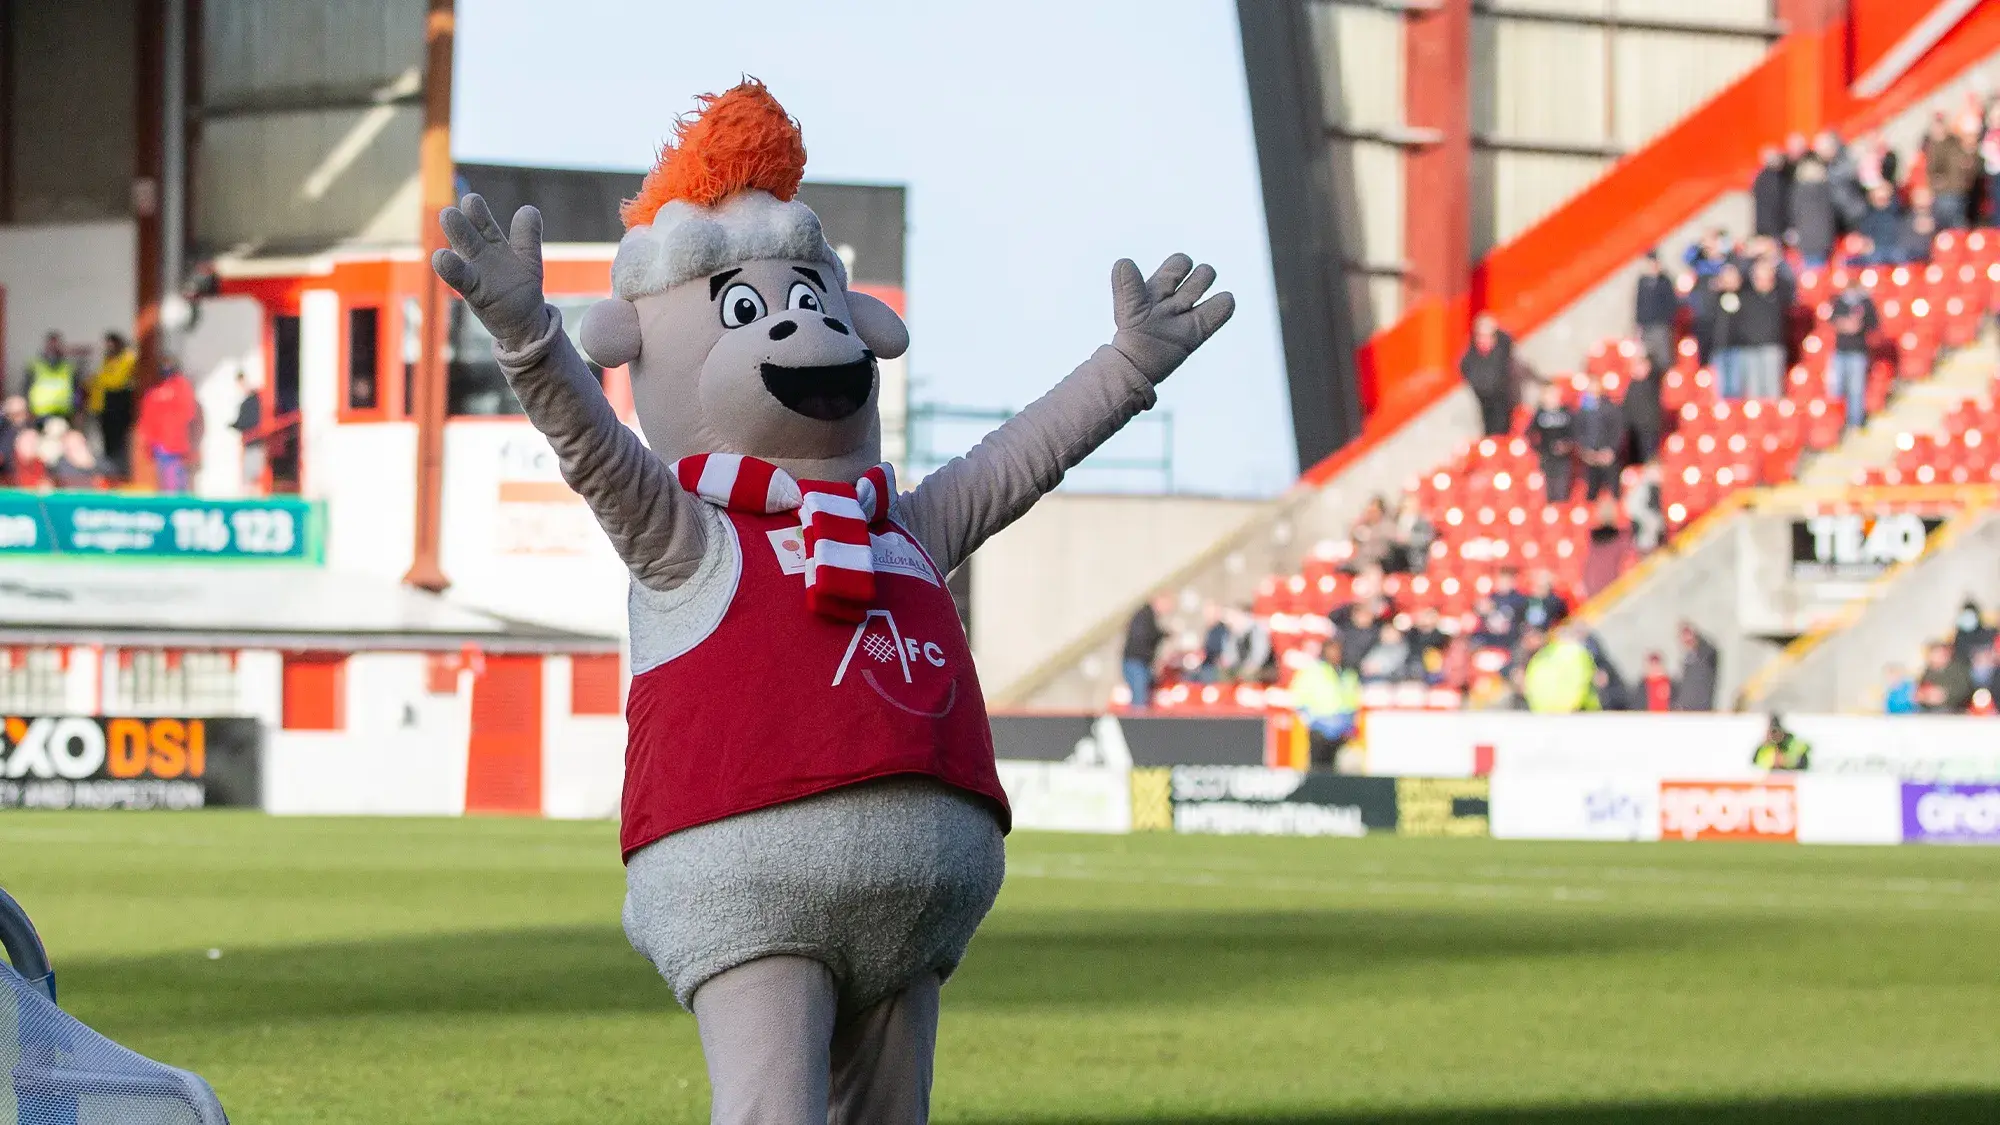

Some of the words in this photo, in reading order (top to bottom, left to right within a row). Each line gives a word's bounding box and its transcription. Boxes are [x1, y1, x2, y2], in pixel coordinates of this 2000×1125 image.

[170, 508, 230, 552] 116
[231, 508, 295, 553] 123
[872, 549, 931, 577] sationALL
[107, 717, 206, 779] DSI
[1662, 786, 1795, 841] sports
